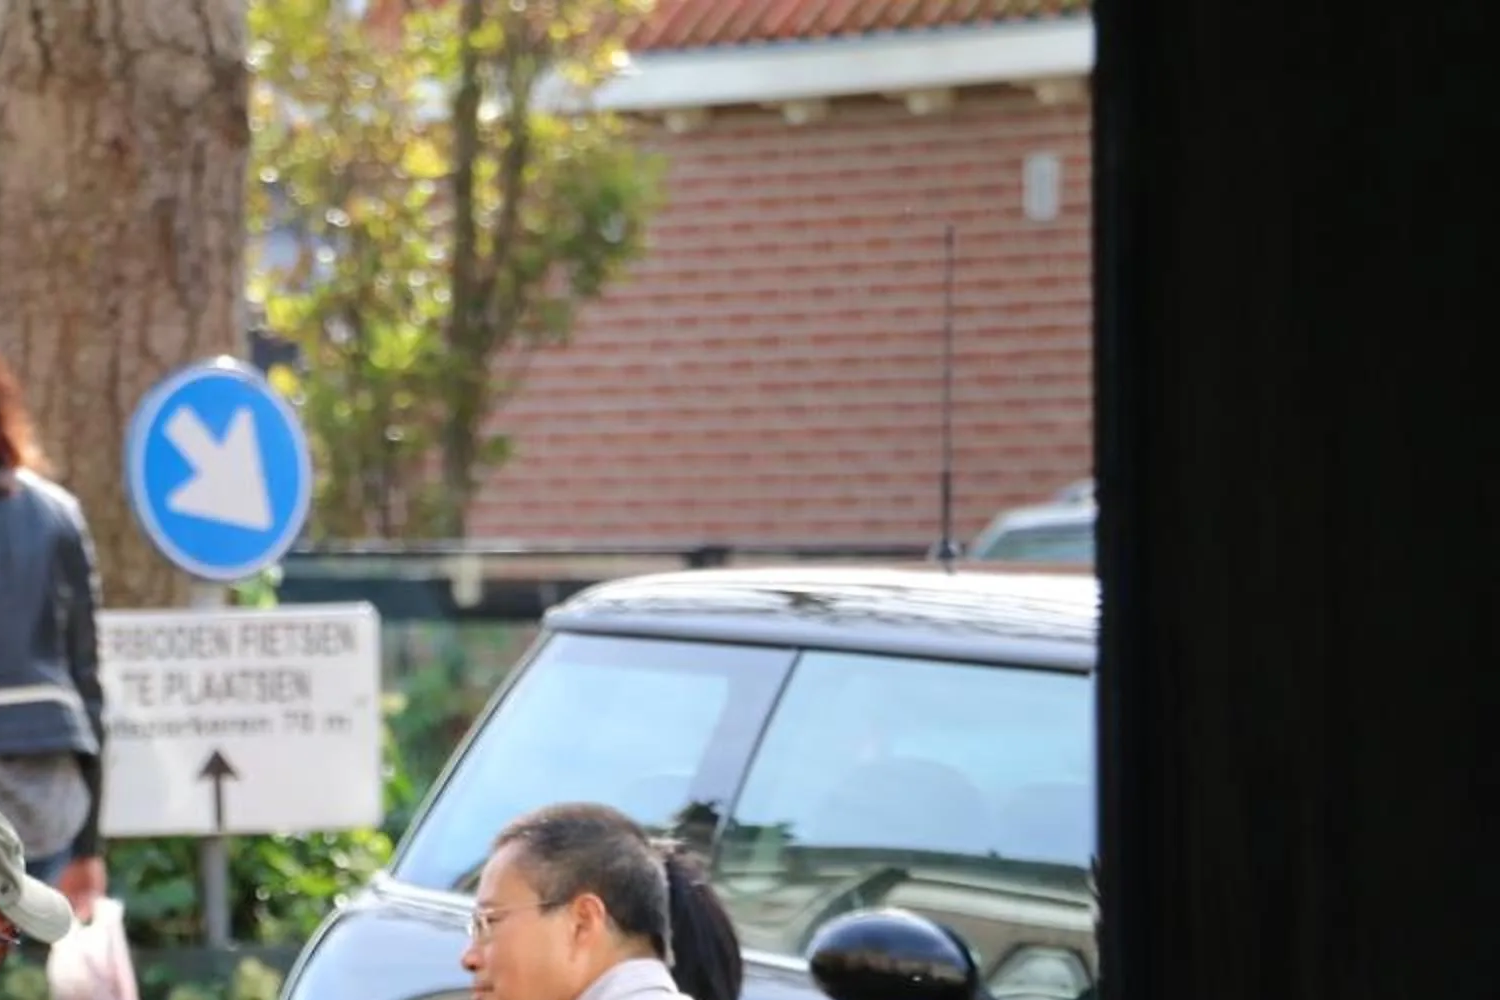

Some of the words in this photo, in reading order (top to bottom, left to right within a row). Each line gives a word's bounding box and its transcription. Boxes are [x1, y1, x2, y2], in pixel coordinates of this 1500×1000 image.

[101, 623, 231, 660] RBODEN
[238, 620, 358, 656] FIETSEN
[120, 671, 153, 706] TE
[161, 667, 312, 704] PLAATSEN
